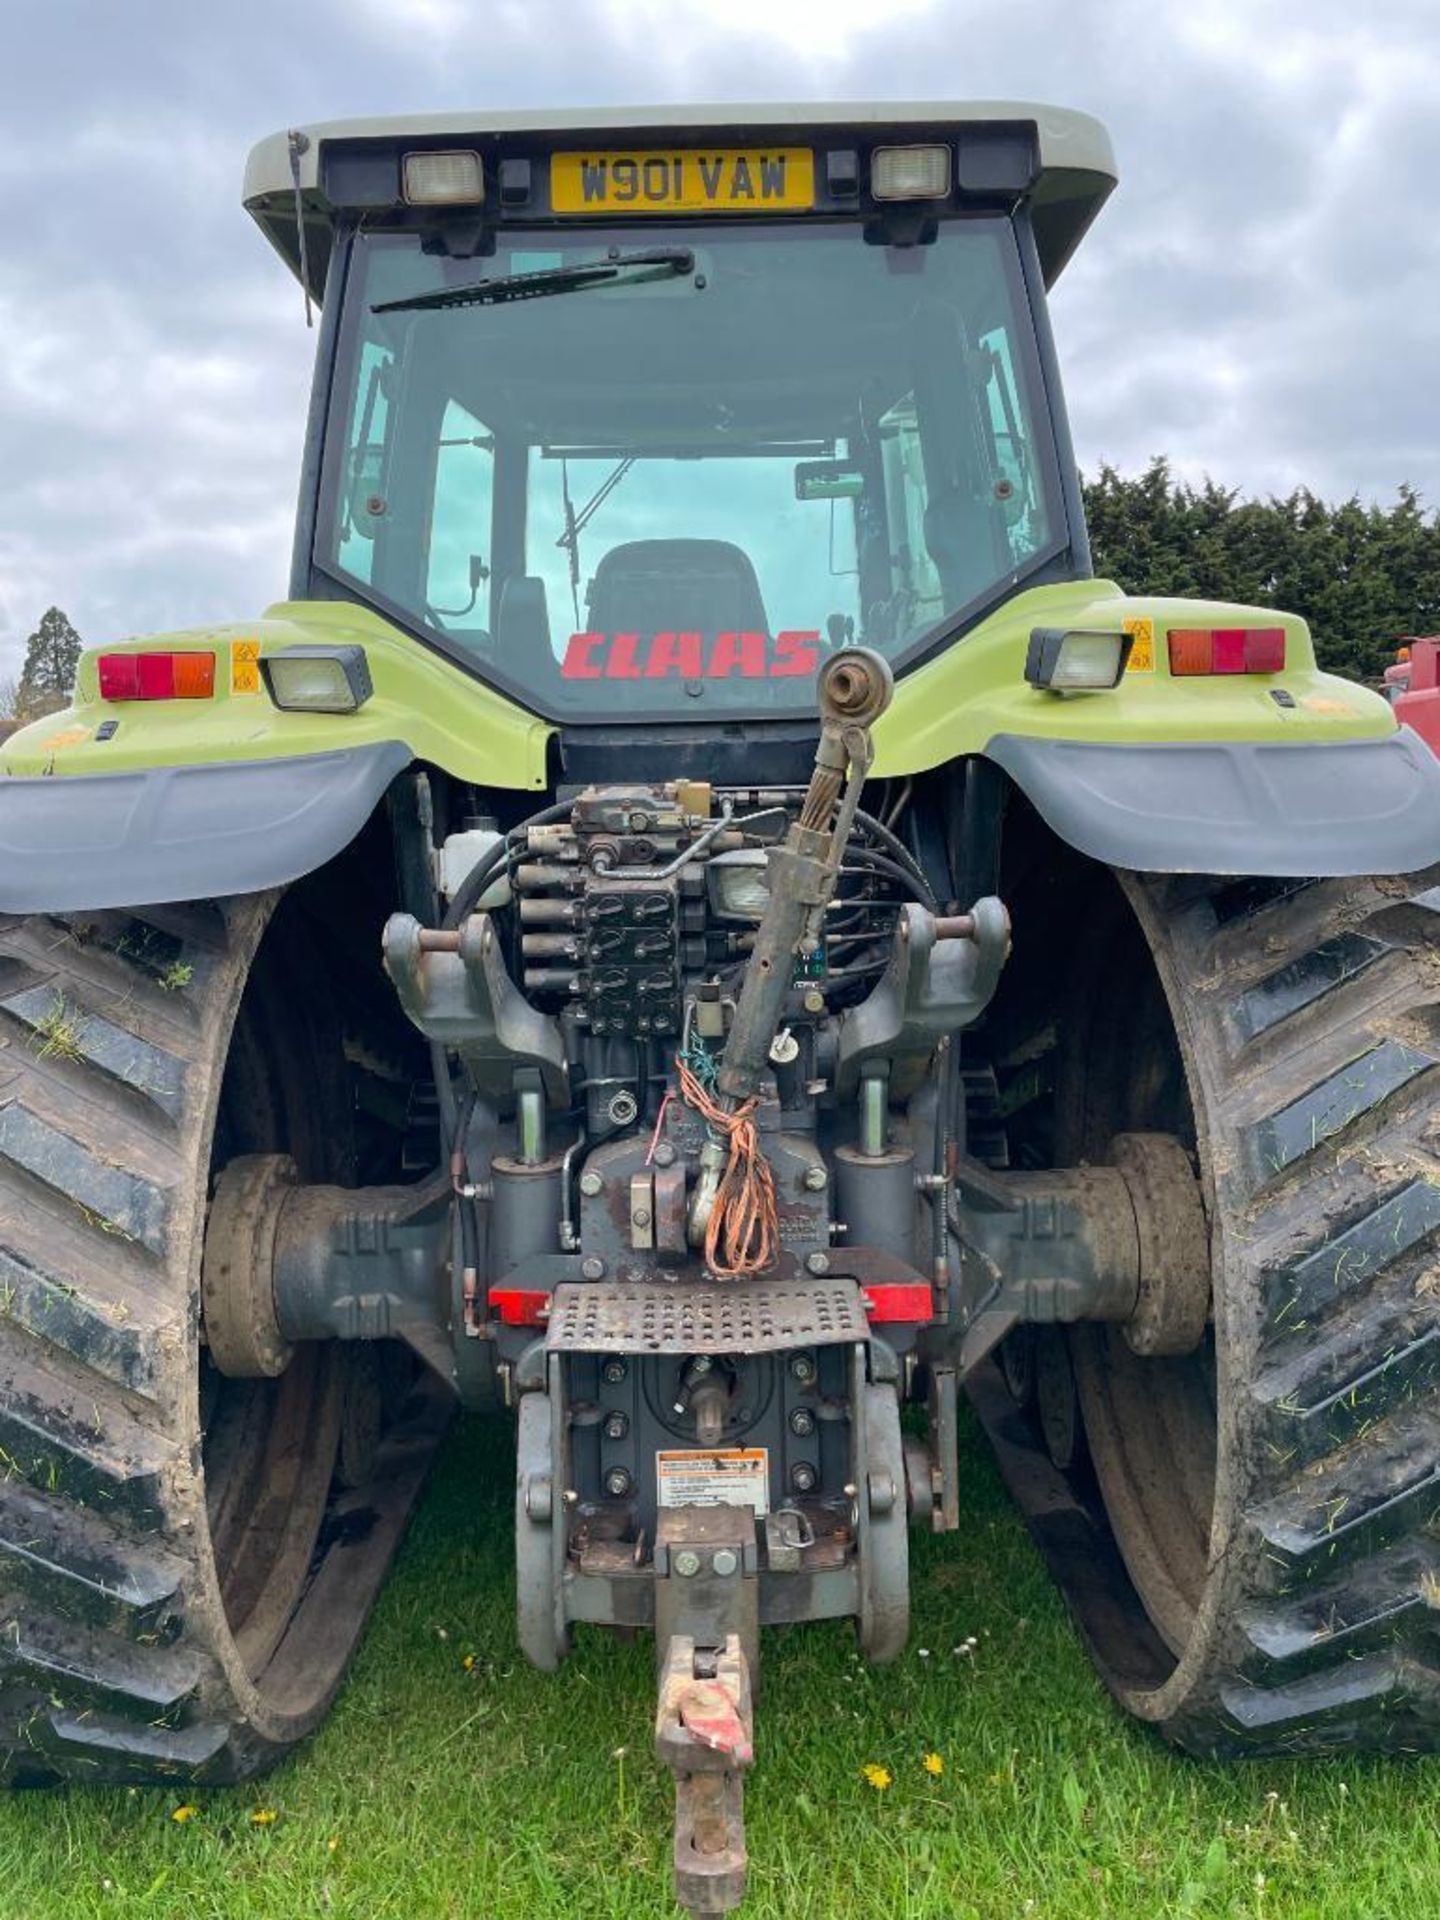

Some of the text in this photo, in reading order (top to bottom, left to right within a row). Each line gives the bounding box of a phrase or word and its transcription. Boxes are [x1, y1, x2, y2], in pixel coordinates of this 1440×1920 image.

[581, 155, 786, 203] W901 VAW
[560, 630, 821, 680] CLAAS
